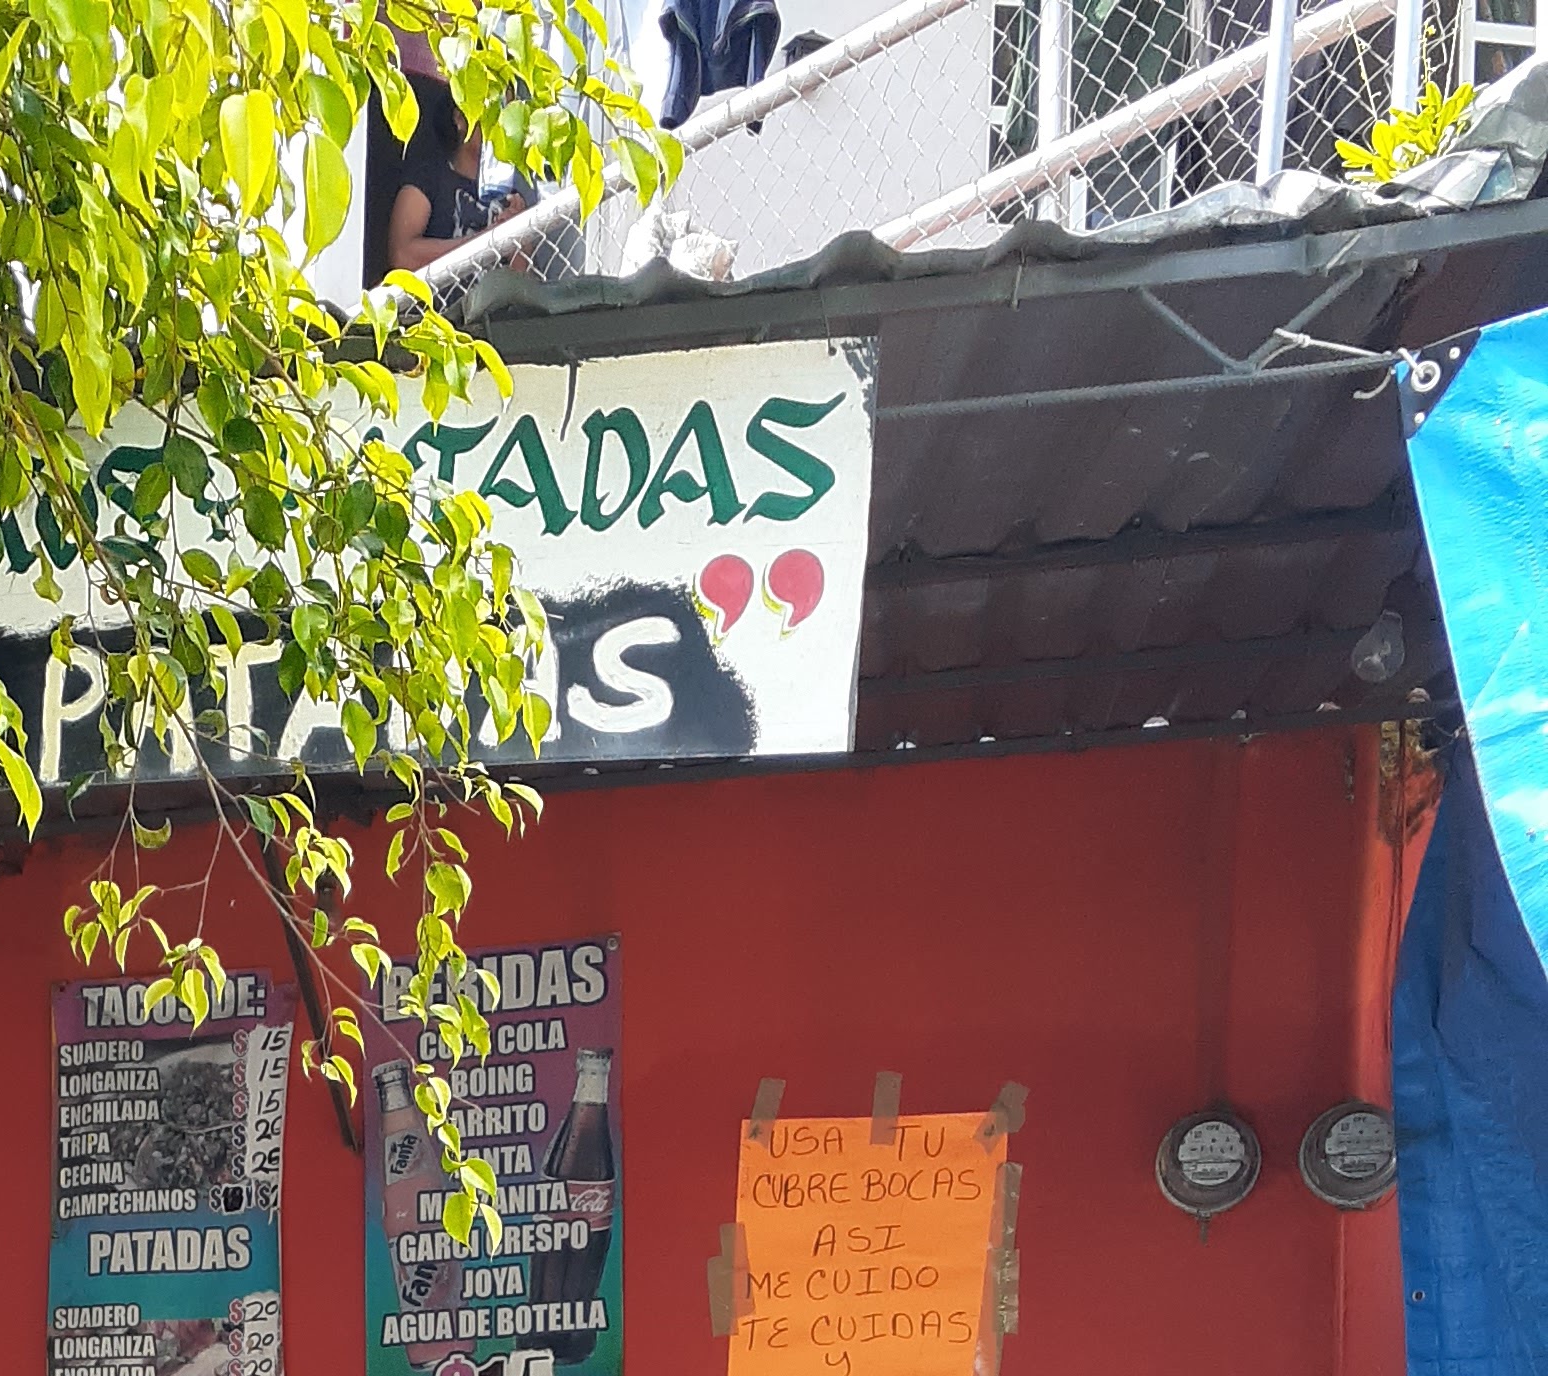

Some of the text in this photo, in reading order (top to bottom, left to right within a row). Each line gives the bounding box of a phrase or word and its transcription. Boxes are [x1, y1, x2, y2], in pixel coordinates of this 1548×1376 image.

[82, 984, 208, 1027] TACO
[60, 1040, 144, 1067] SUADERO
[420, 1021, 565, 1061] CO COLA
[60, 1070, 159, 1097] LONGANIZA
[452, 1064, 533, 1098] BOING
[60, 1100, 160, 1128] ENCHILADA
[444, 1102, 546, 1138] ARRITO
[60, 1132, 110, 1158] TRIPA
[769, 1124, 946, 1161] USA TU
[60, 1162, 124, 1188] CECINA
[59, 1189, 196, 1220] CAMPECHANOS
[419, 1182, 567, 1221] MANITA
[89, 1228, 250, 1275] PATADAS
[812, 1223, 906, 1257] ASI
[462, 1266, 524, 1298] JOYA
[746, 1265, 940, 1301] ME CUIDO
[54, 1305, 139, 1330] SUADERO
[383, 1300, 607, 1345] AGUA DE BOTELLA
[741, 1310, 973, 1350] TE CUIDAS
[54, 1335, 156, 1359] LONGANIZA
